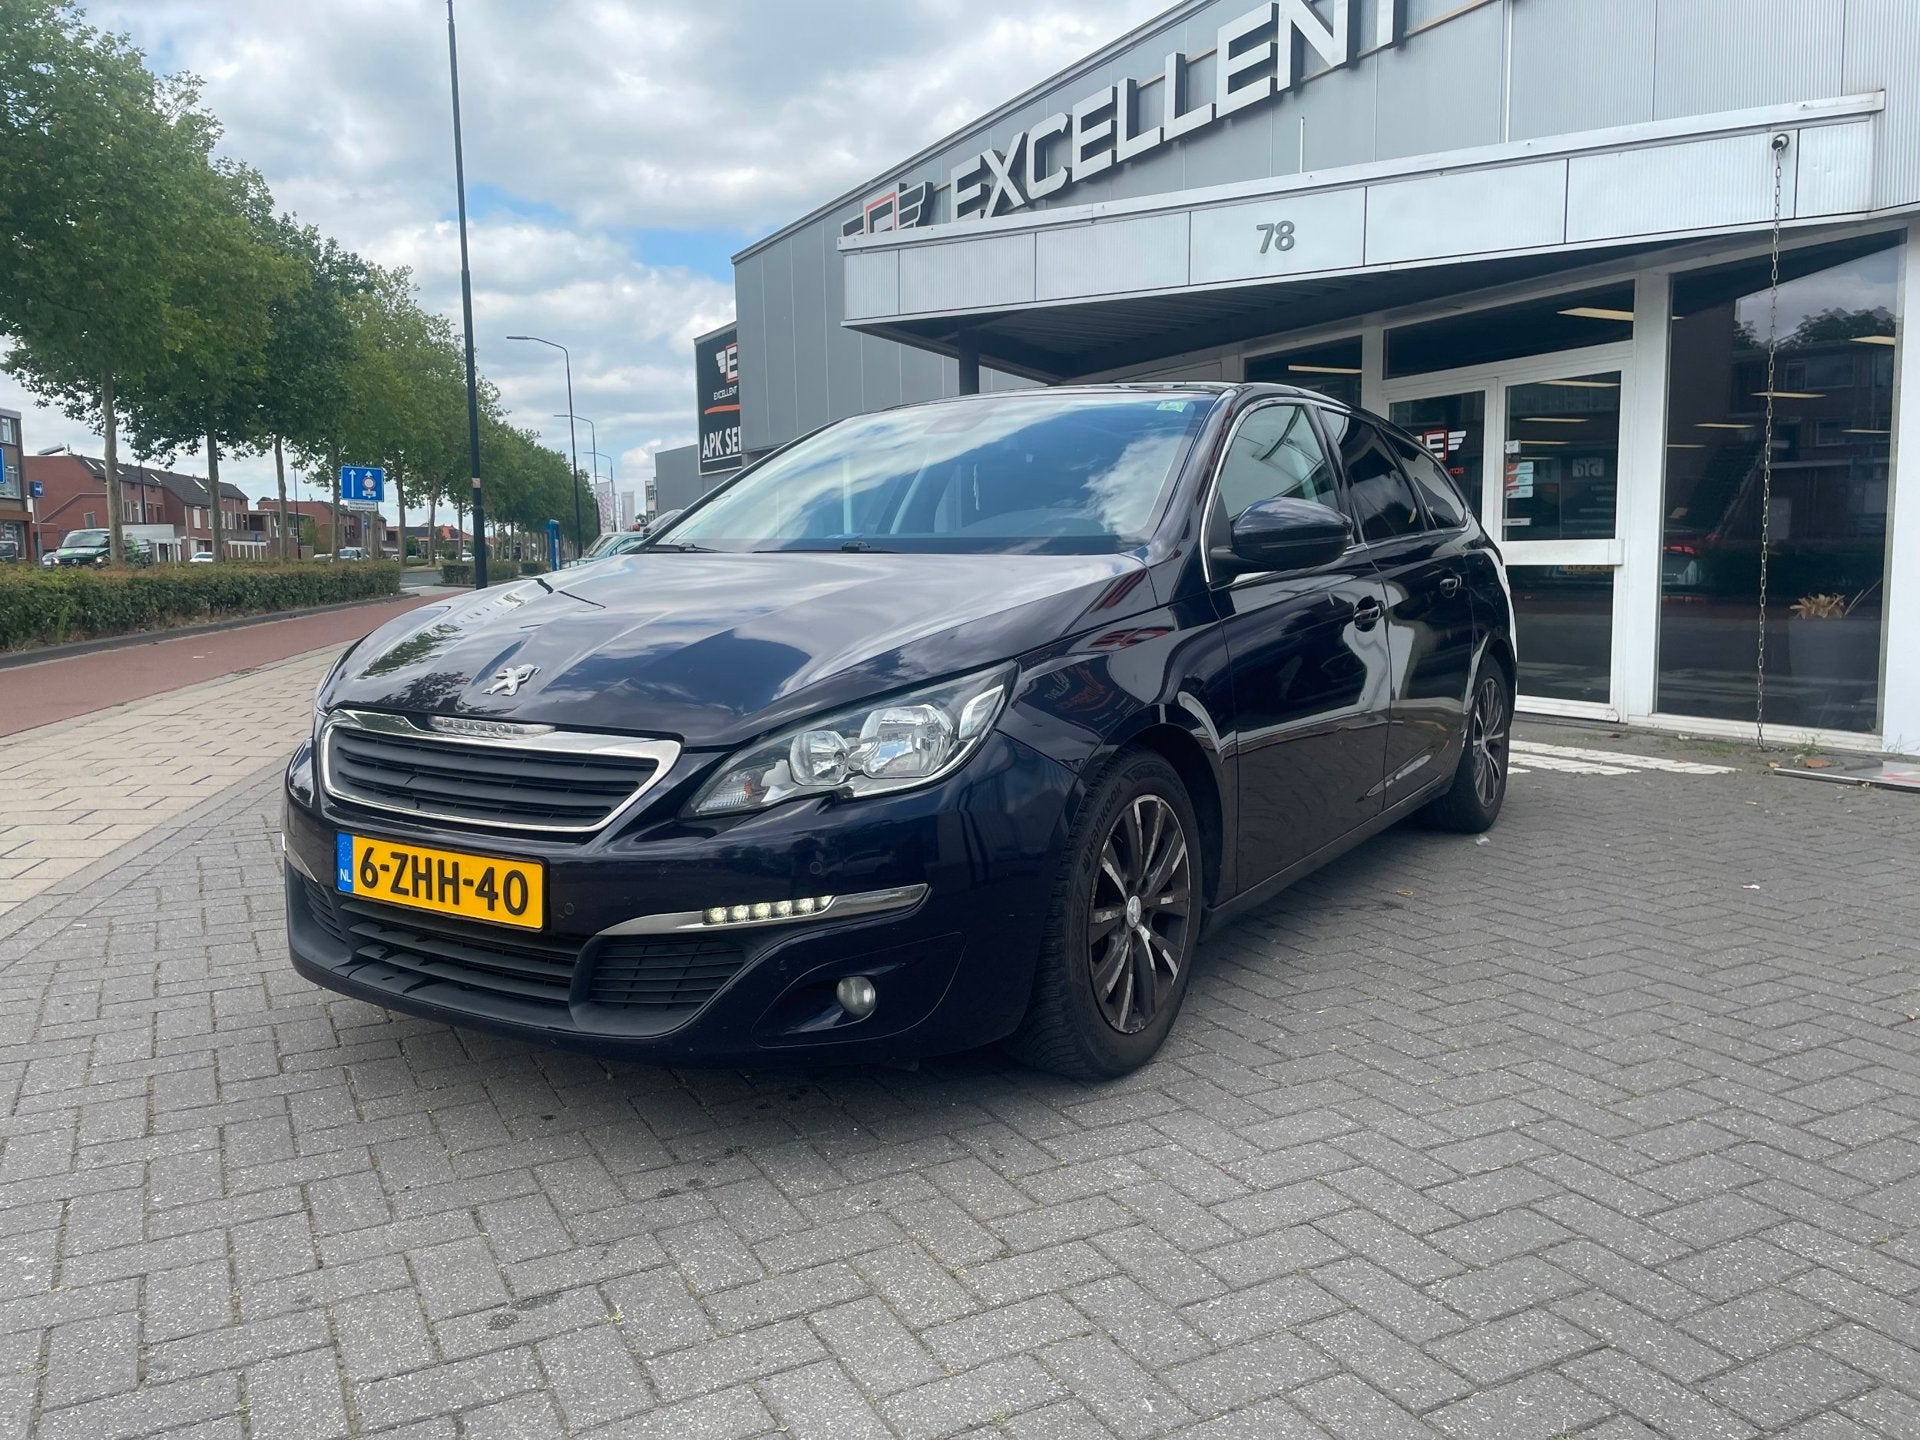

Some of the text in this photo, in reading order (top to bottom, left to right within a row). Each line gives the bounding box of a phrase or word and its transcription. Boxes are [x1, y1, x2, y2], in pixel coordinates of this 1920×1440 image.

[1256, 220, 1295, 254] 78
[713, 385, 738, 401] EXCELLENT
[702, 425, 742, 459] APK SE
[441, 718, 515, 737] PEUGEOT
[339, 846, 529, 916] NL 6-ZHH-40
